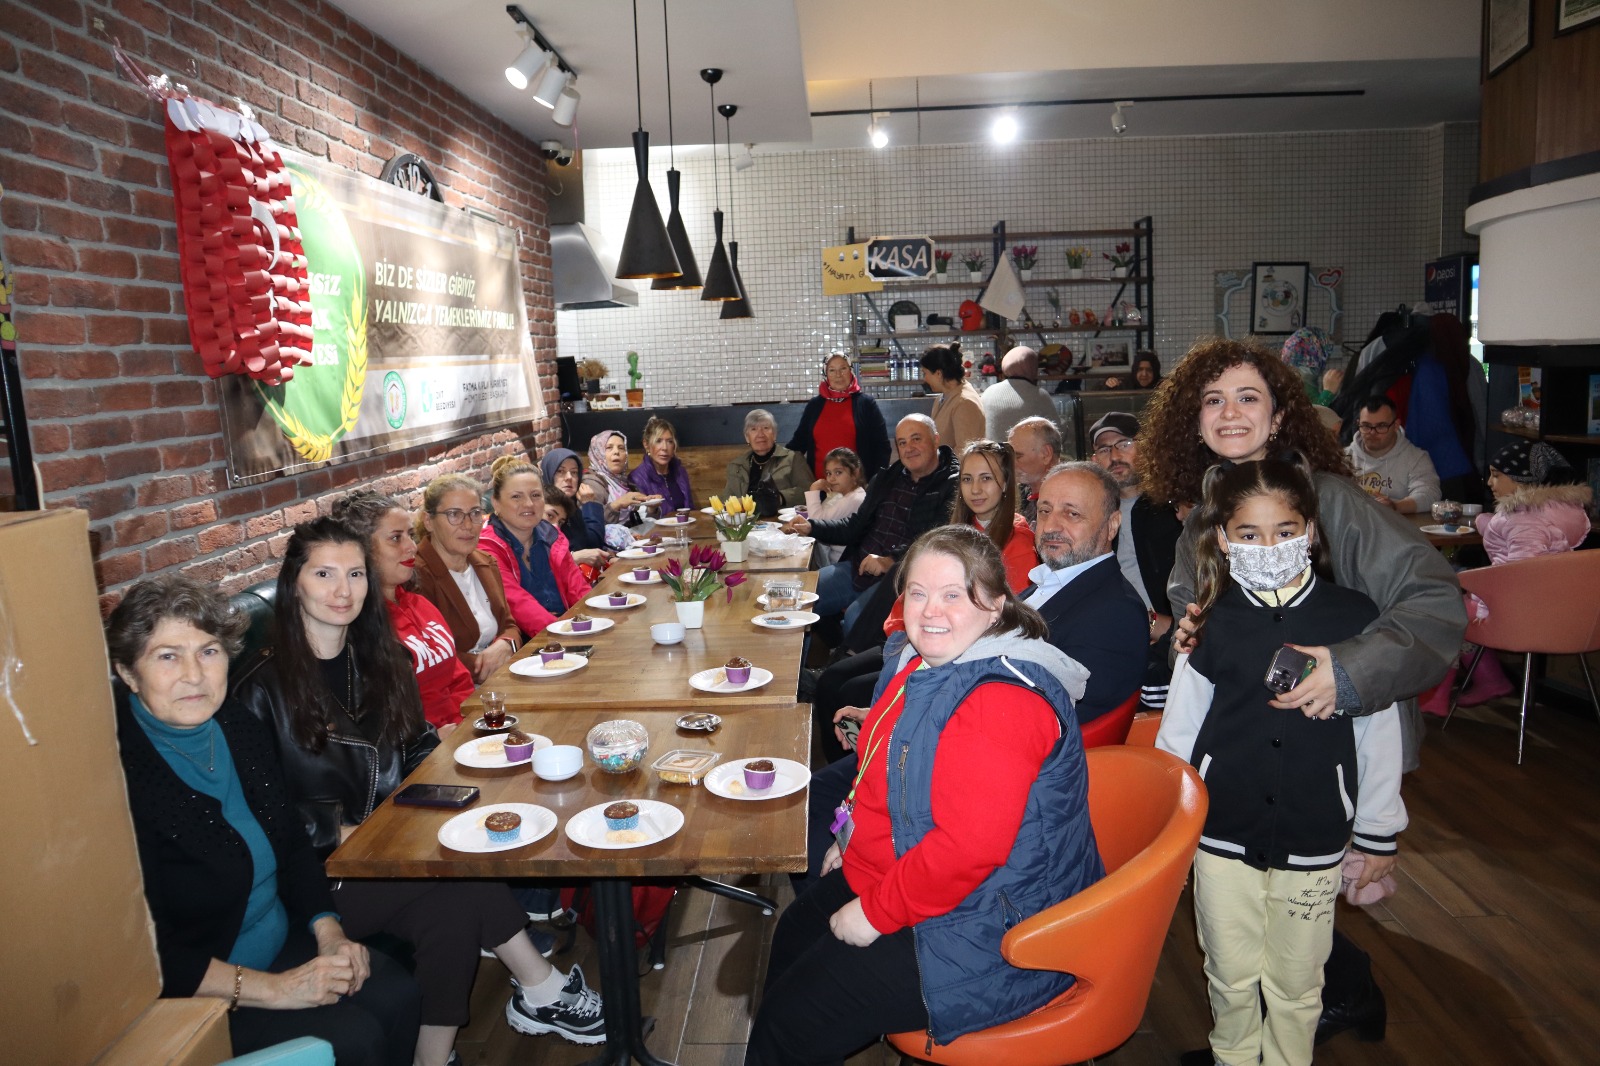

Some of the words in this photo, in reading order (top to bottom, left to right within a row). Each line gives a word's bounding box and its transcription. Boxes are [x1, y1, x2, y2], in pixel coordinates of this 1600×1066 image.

[870, 244, 929, 271] KASA
[374, 257, 396, 288] BİZ
[397, 265, 414, 289] DE
[416, 264, 447, 294] SİZLER
[374, 299, 434, 325] YALNIZCA
[1300, 911, 1312, 921] the
